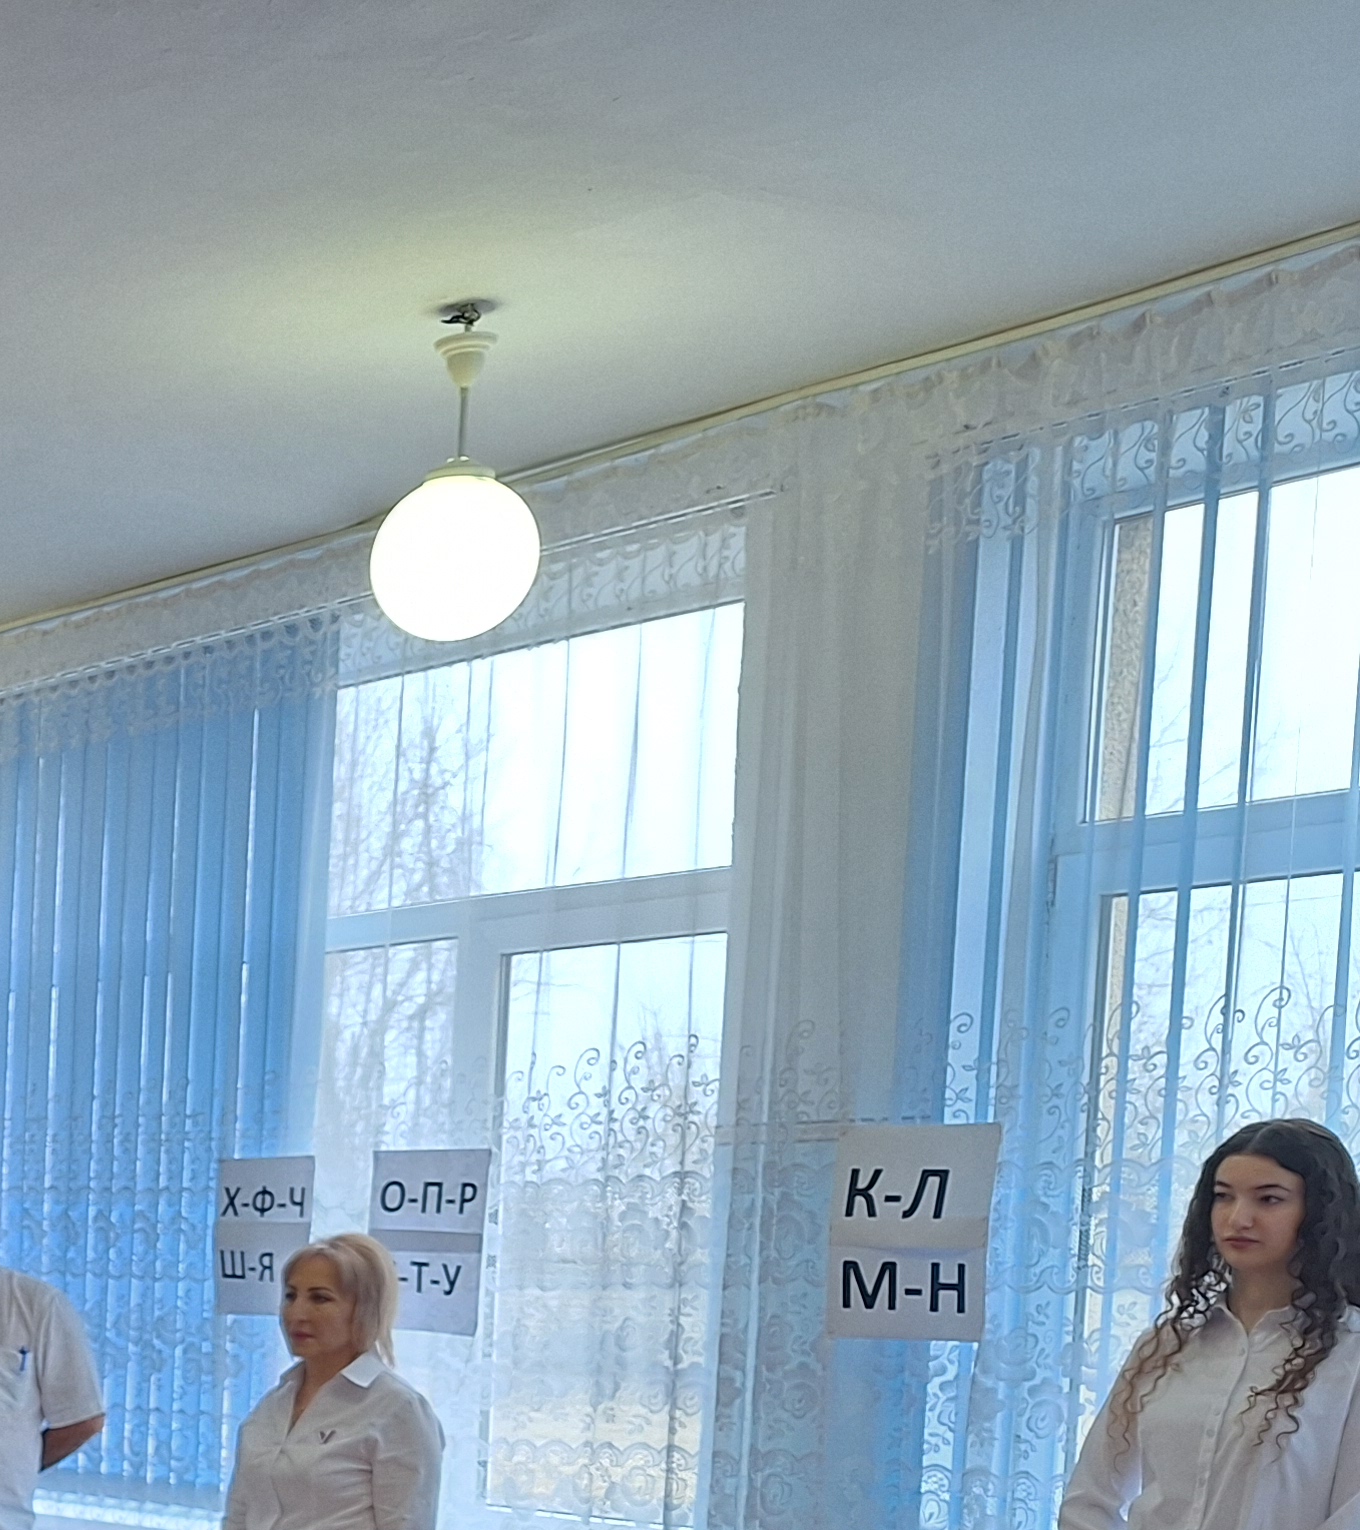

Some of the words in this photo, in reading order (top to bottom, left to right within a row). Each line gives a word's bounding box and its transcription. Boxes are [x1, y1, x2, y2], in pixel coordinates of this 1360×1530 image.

[220, 1185, 306, 1219] Х-Ф-Ч
[380, 1180, 478, 1215] О-П-Р
[845, 1168, 950, 1219] К-Л
[220, 1250, 275, 1282] Ш-Я
[393, 1259, 462, 1296] -Т-У
[842, 1260, 966, 1313] М-Н
